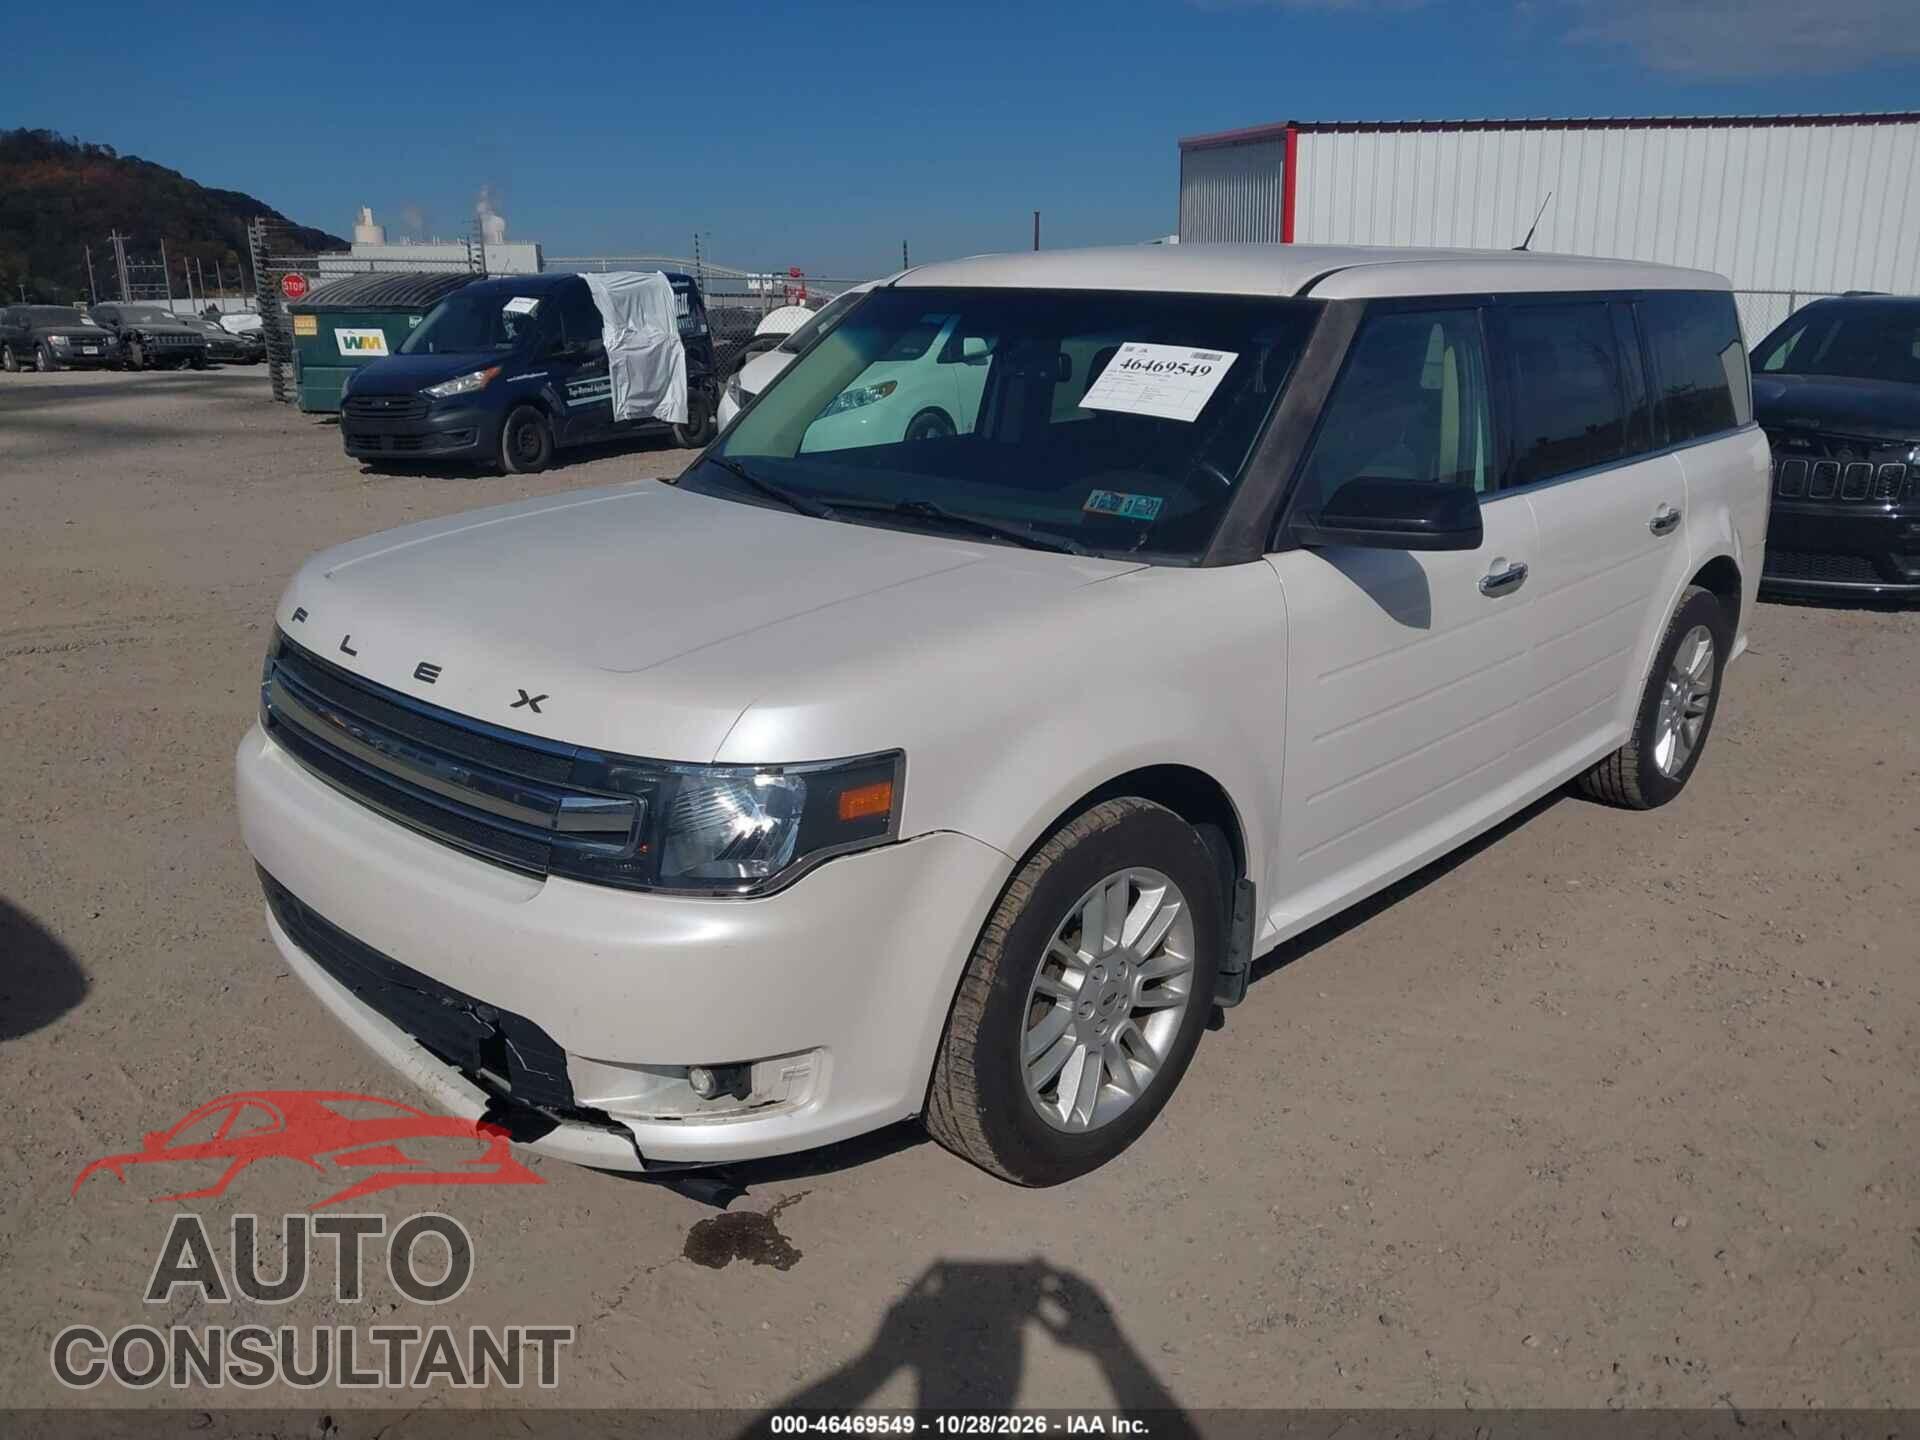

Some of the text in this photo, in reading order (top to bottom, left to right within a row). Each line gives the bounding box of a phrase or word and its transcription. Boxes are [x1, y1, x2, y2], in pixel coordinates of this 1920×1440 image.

[283, 281, 304, 291] STOP
[342, 336, 381, 349] WM
[1119, 357, 1213, 377] 46469549
